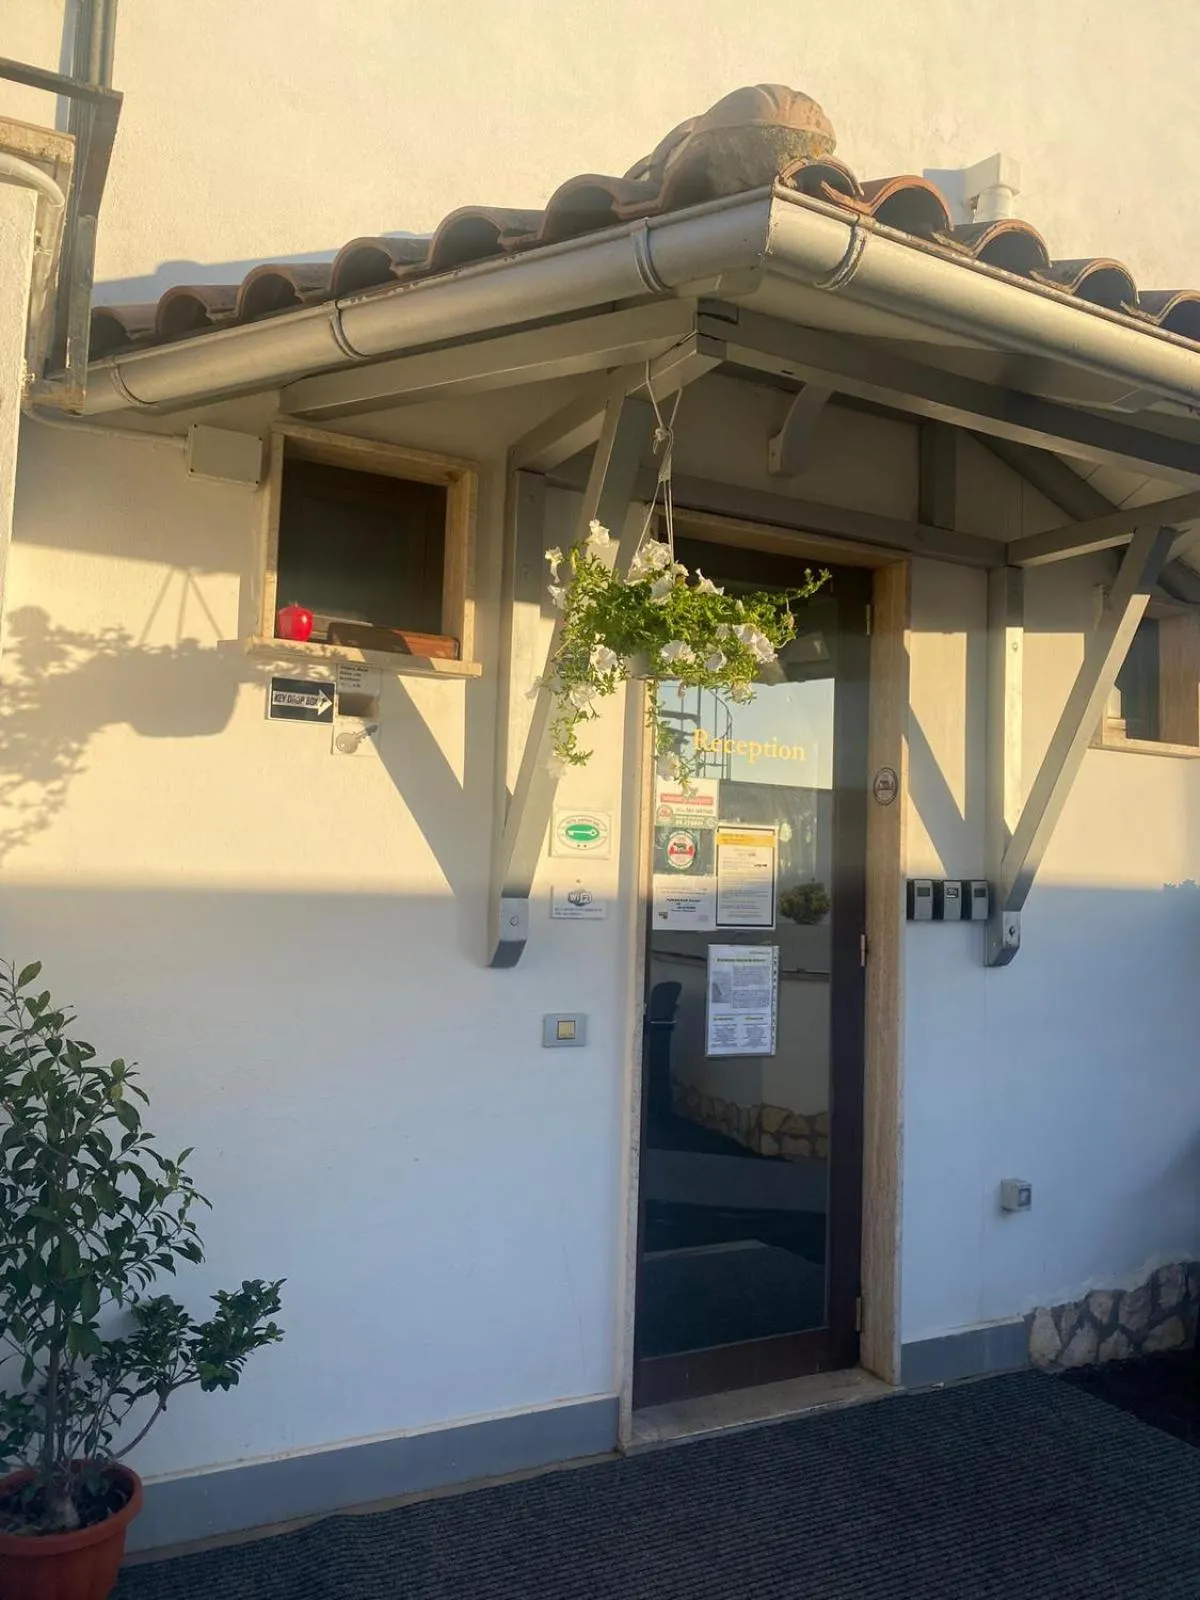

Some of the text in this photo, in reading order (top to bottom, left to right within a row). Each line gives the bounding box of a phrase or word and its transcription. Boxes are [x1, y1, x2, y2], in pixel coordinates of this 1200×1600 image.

[274, 693, 287, 703] KEY
[287, 694, 305, 705] DROP
[694, 728, 806, 764] Reception
